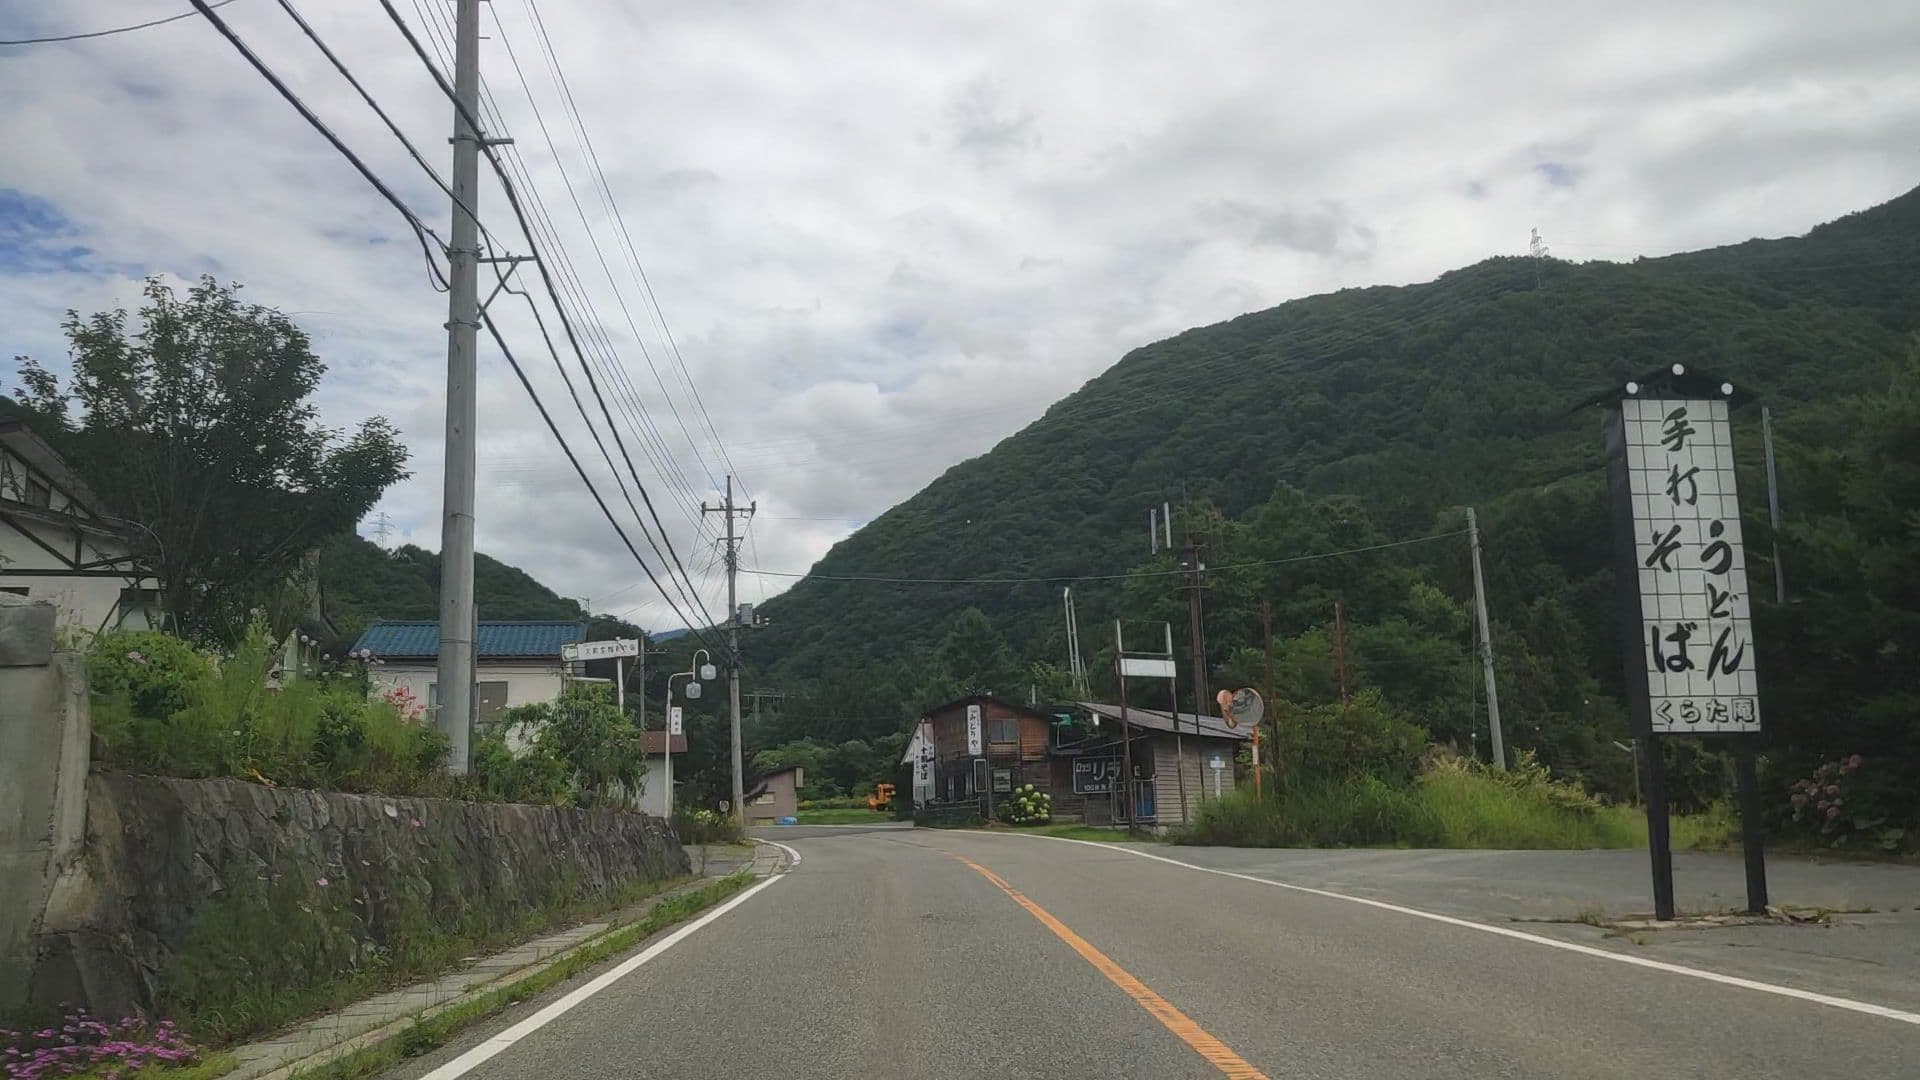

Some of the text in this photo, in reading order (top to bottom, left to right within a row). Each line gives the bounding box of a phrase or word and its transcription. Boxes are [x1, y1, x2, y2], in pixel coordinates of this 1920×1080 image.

[1644, 523, 1699, 674] そば
[1700, 519, 1745, 682] うどん
